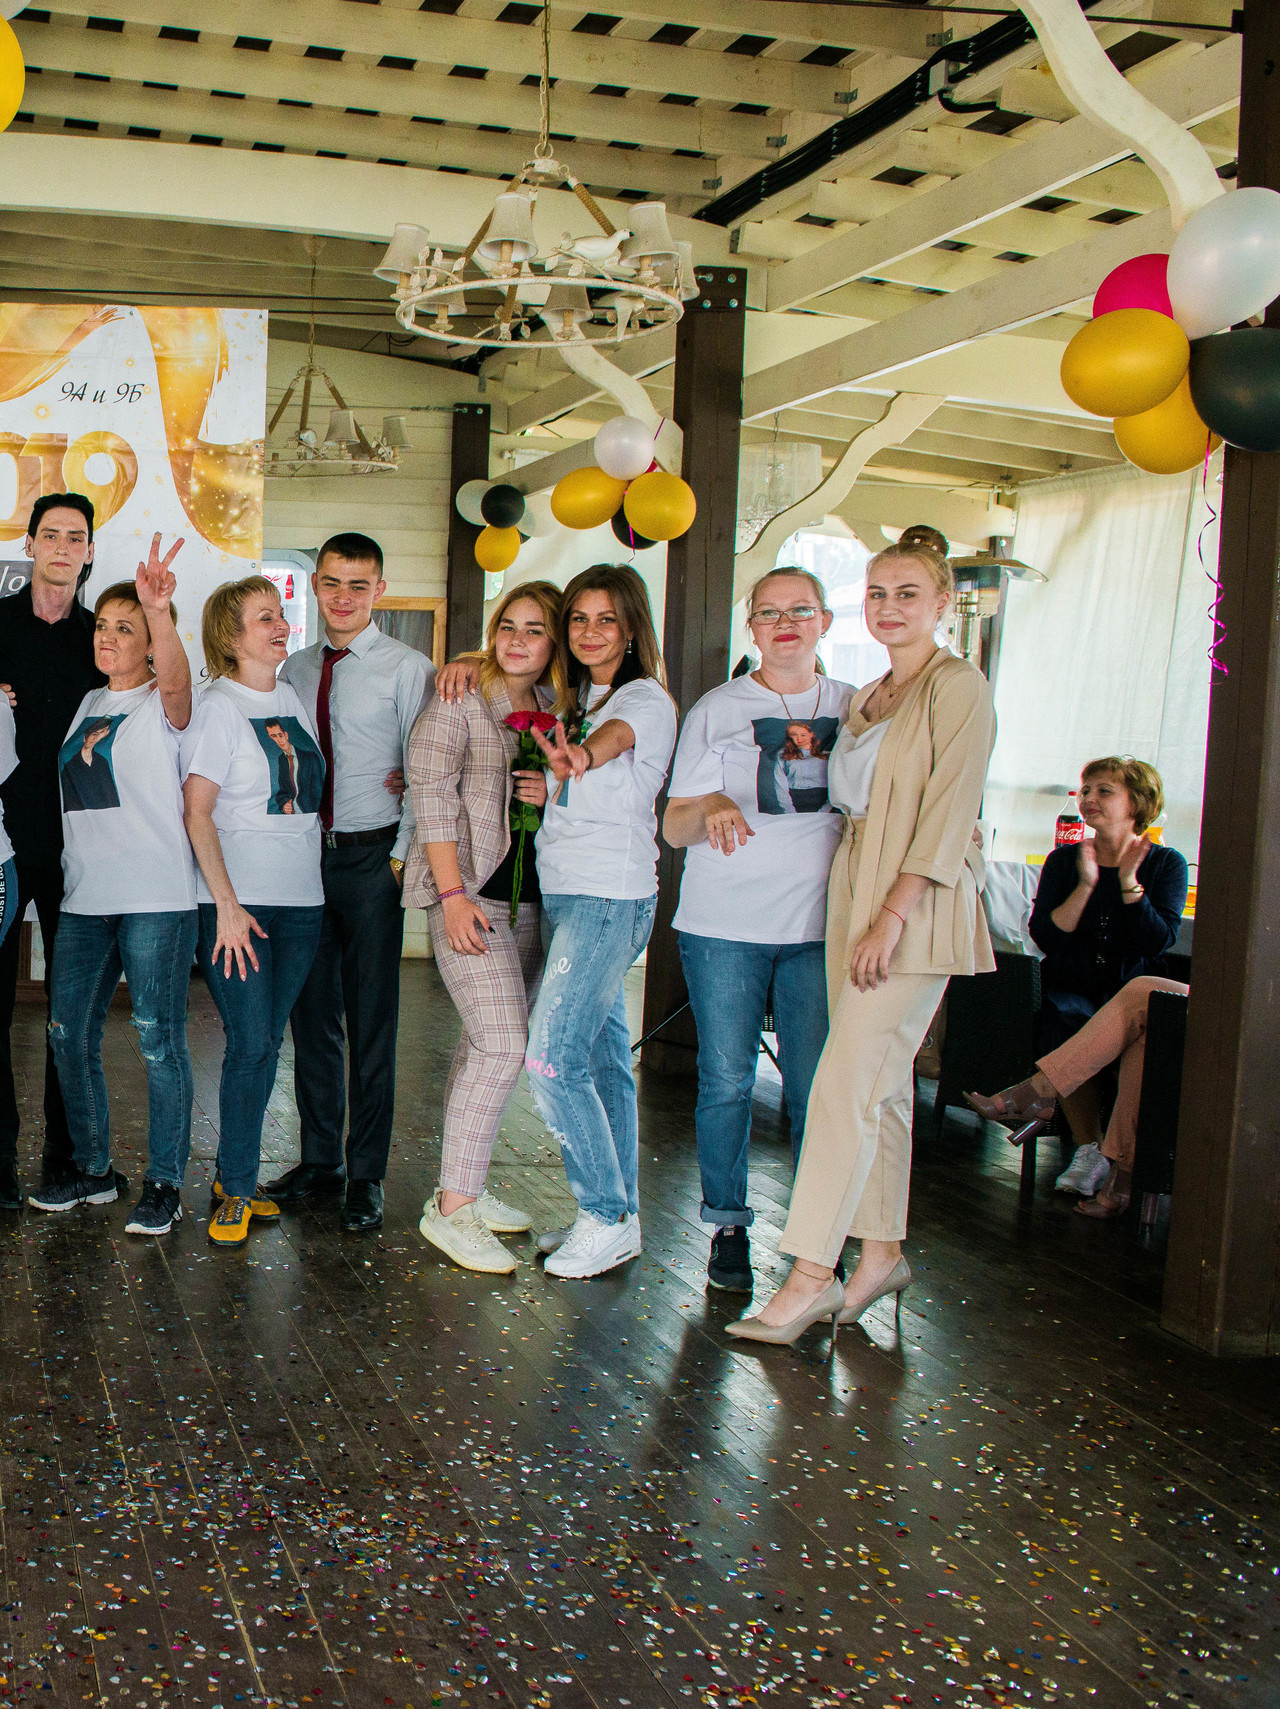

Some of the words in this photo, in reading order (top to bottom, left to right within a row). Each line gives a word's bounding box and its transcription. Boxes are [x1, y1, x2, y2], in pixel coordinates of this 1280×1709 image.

[57, 381, 88, 402] 9А
[92, 390, 108, 403] и
[113, 383, 145, 404] 9Б
